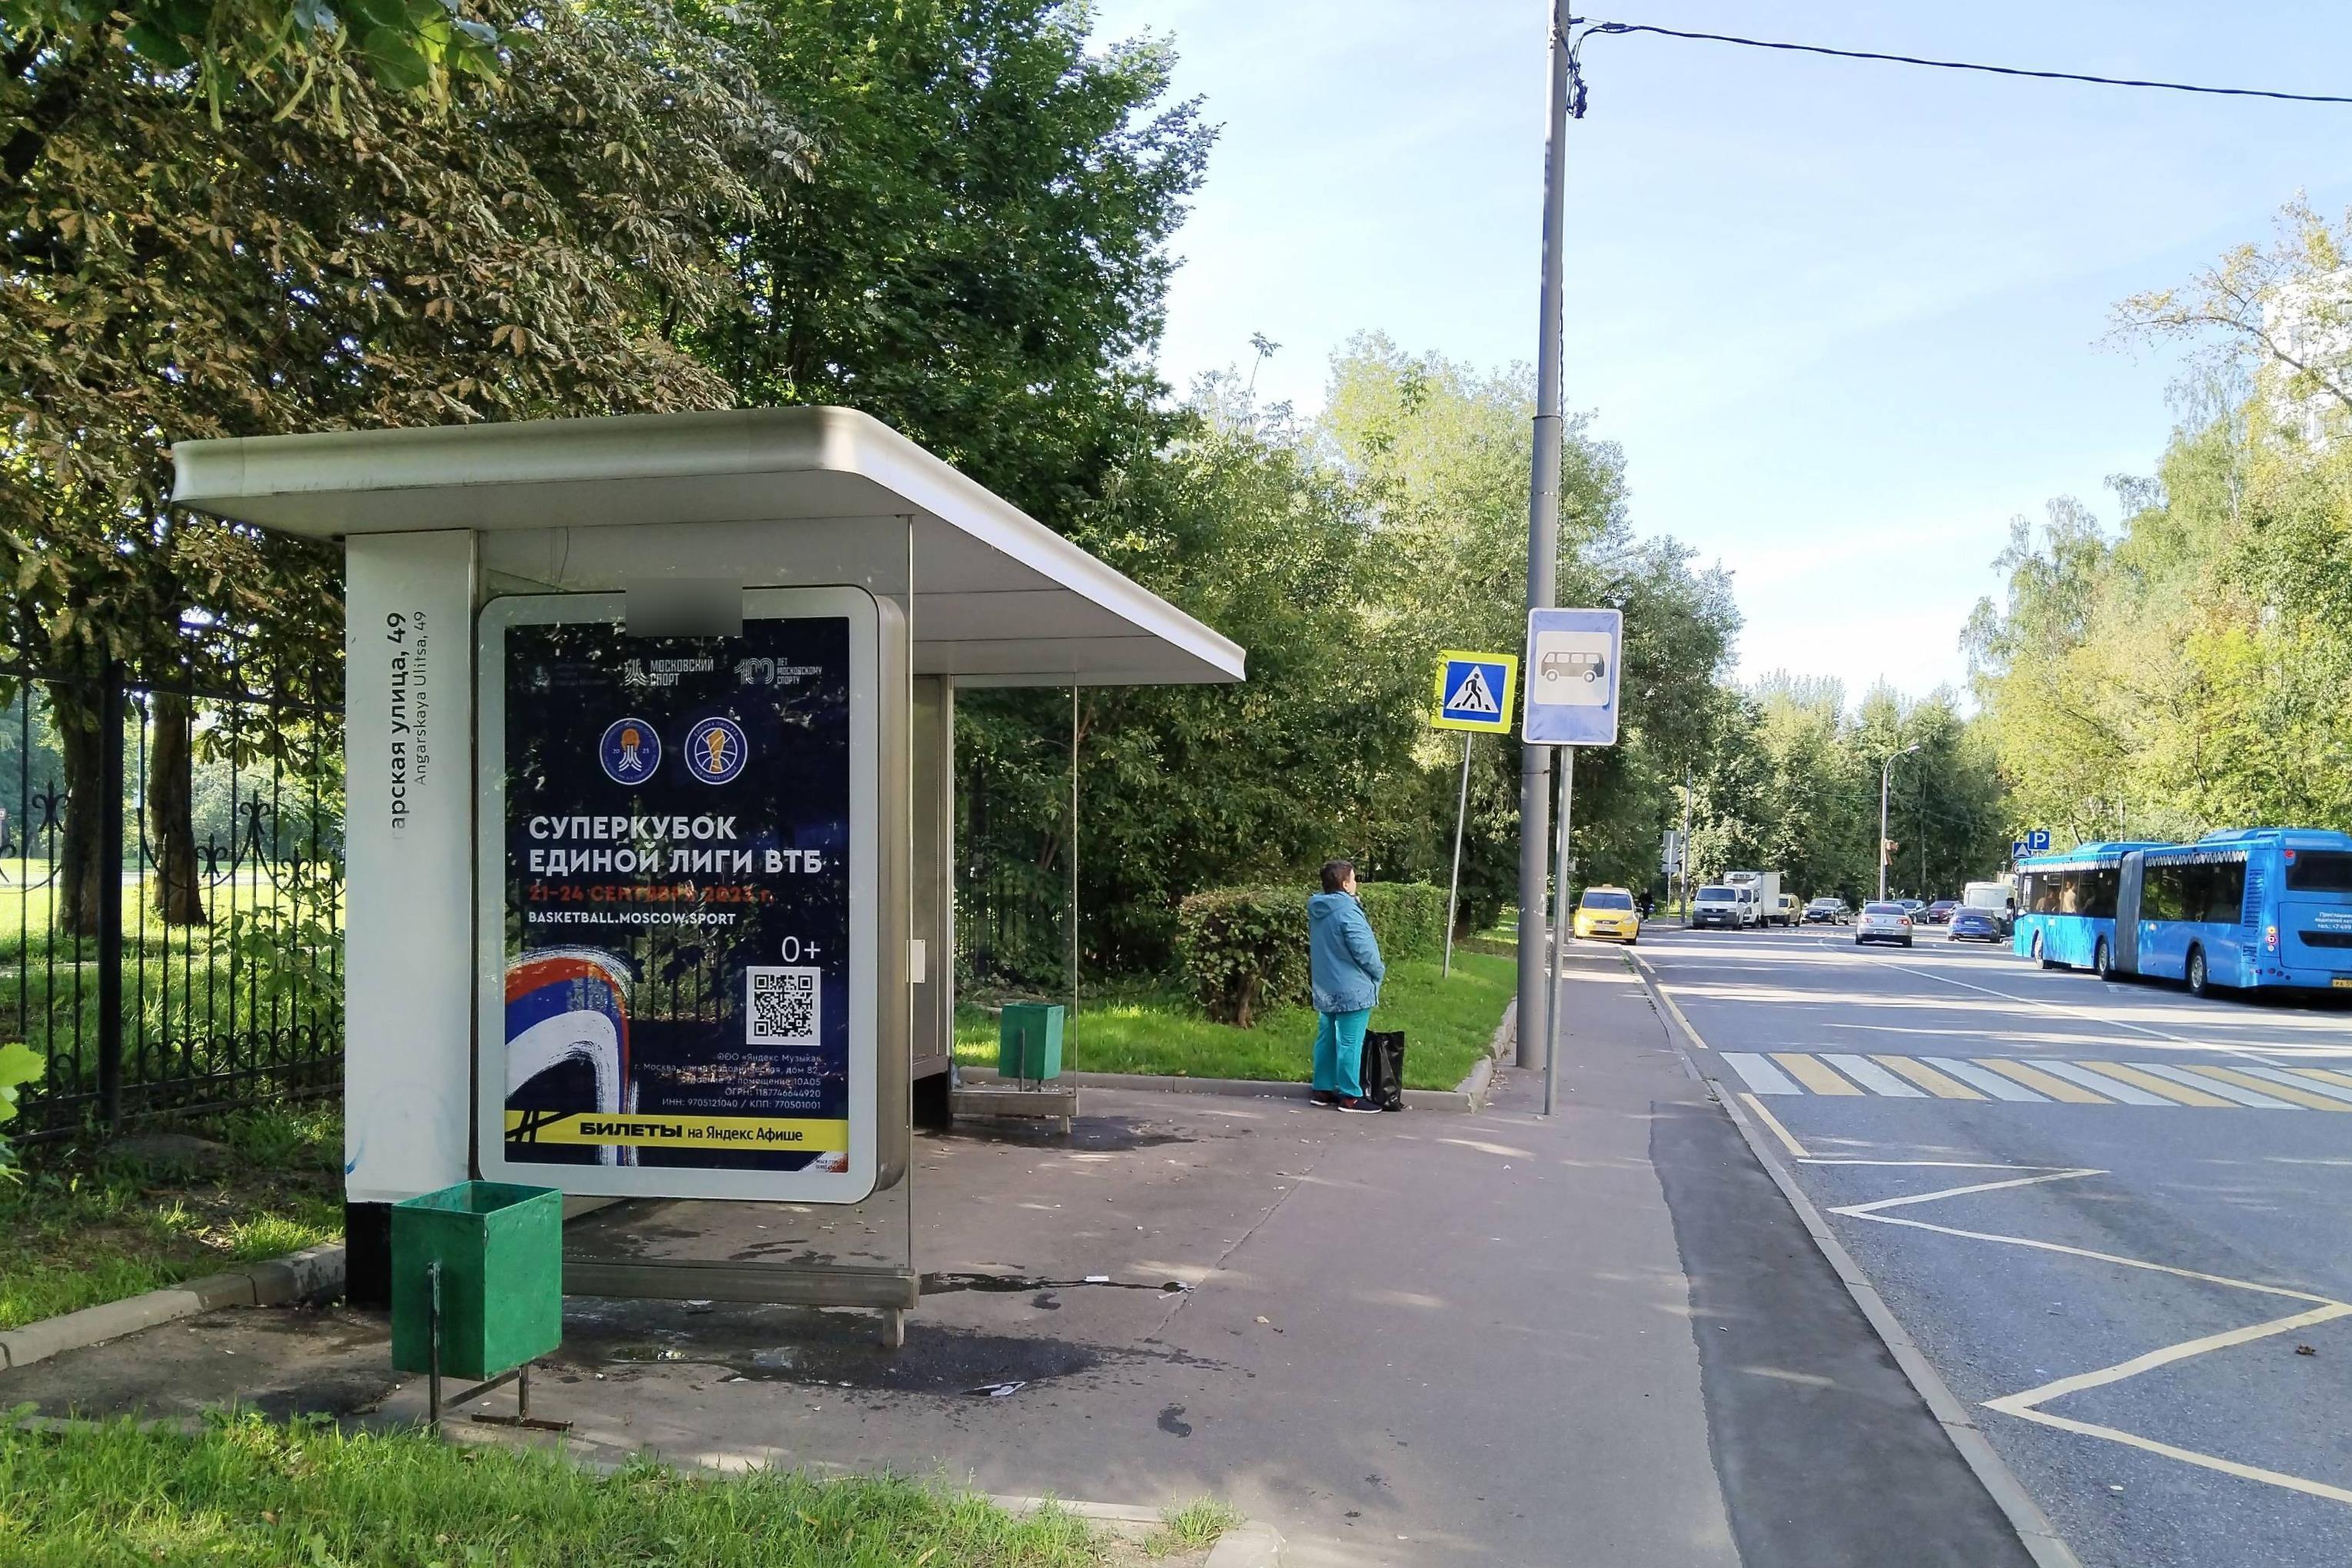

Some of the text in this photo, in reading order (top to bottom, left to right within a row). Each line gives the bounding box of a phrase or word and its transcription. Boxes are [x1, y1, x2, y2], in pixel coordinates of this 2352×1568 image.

[387, 613, 406, 643] 49
[649, 658, 713, 673] МОСКОВСКИЙ
[777, 666, 822, 676] МОСКОВСКОМУ
[649, 673, 679, 686] СПОРТ
[777, 676, 800, 685] СПОРТУ
[391, 651, 410, 734] улица,
[413, 611, 430, 786] Angarskaya Ulitsa, 49
[529, 816, 737, 840] СУПЕРКУБОК
[530, 841, 822, 877] ЕДИНОЙ ЛИГИ ВТБ
[528, 911, 736, 925] BASKETBALL.MOSCOW.SPORT
[782, 935, 821, 962] 0+
[724, 1088, 752, 1096] ОГРН:
[662, 1098, 685, 1107] ИНН:
[749, 1099, 771, 1108] КПП:
[580, 1121, 803, 1142] БИЛЕТЫ на Яндекс Афише
